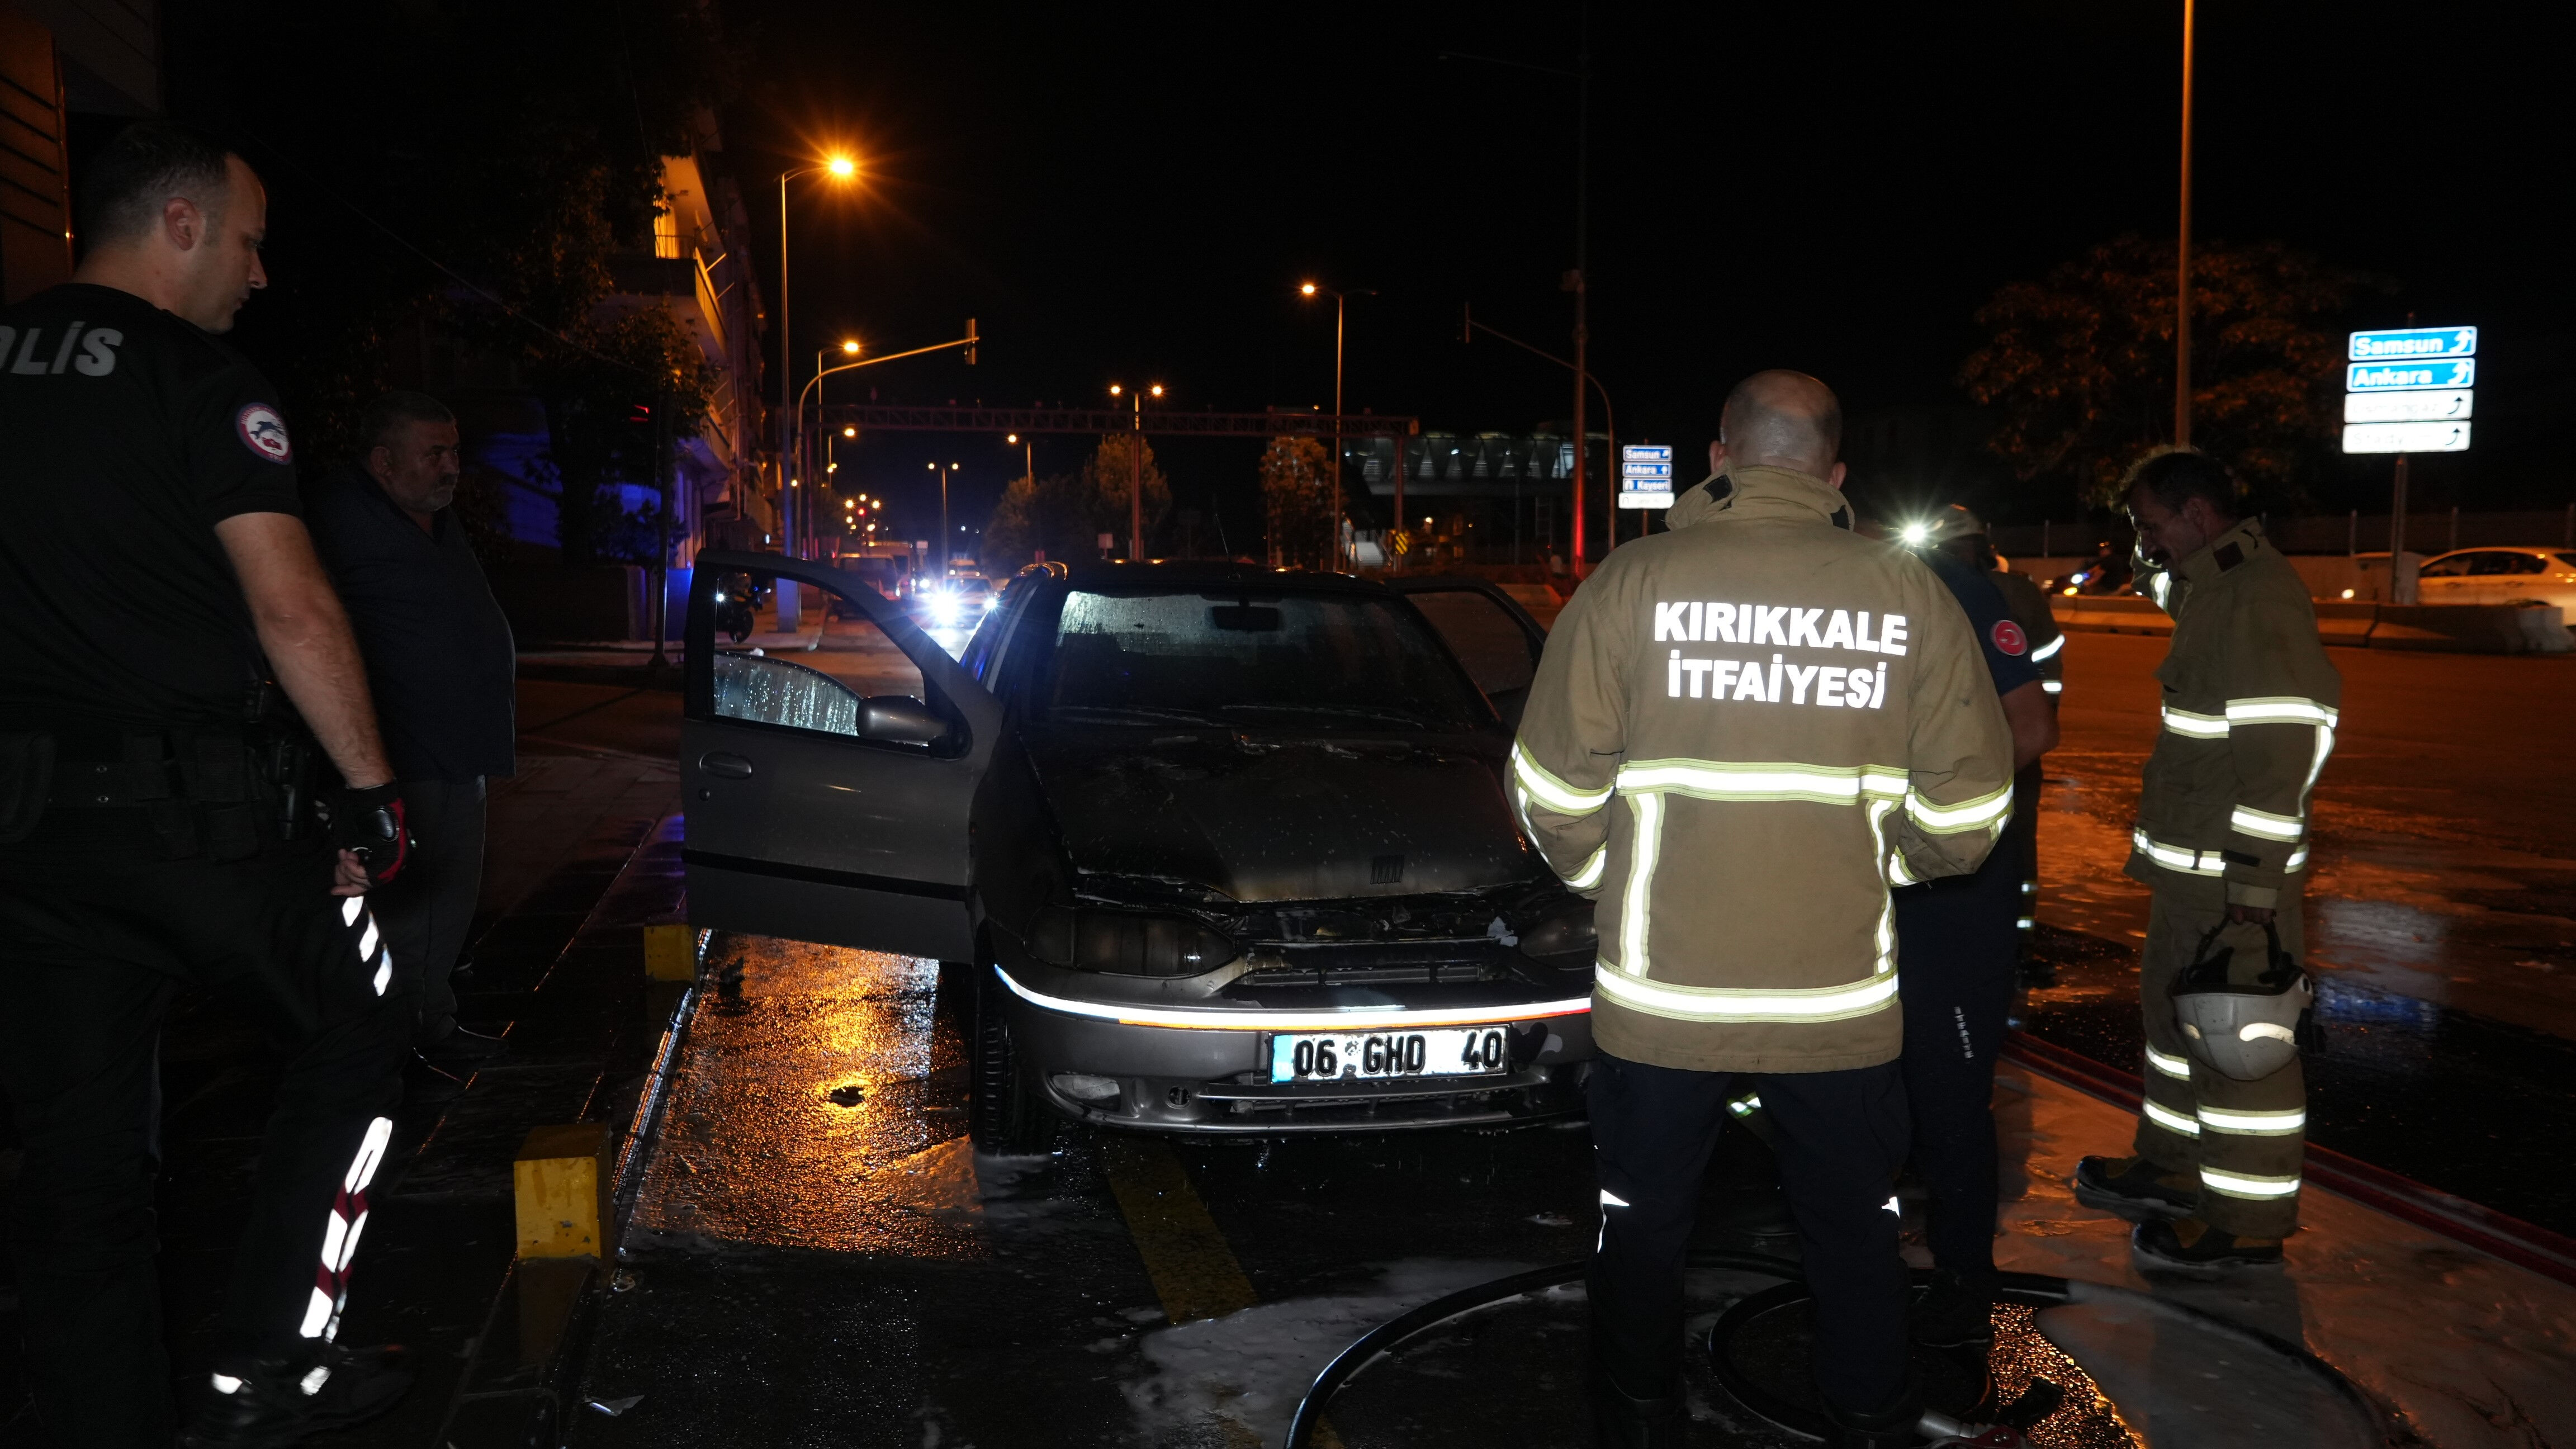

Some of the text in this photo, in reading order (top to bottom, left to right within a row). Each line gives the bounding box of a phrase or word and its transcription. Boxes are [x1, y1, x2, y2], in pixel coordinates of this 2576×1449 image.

[2354, 337, 2444, 356] Samsun
[2352, 367, 2432, 387] Ankara
[1626, 449, 1661, 459] Samsun
[1625, 465, 1658, 475] Ankara
[1654, 602, 1907, 656] KIRIKKALE
[1668, 649, 1887, 709] İTFAİYESİ
[1293, 1031, 1503, 1077] 06 GHD 40
